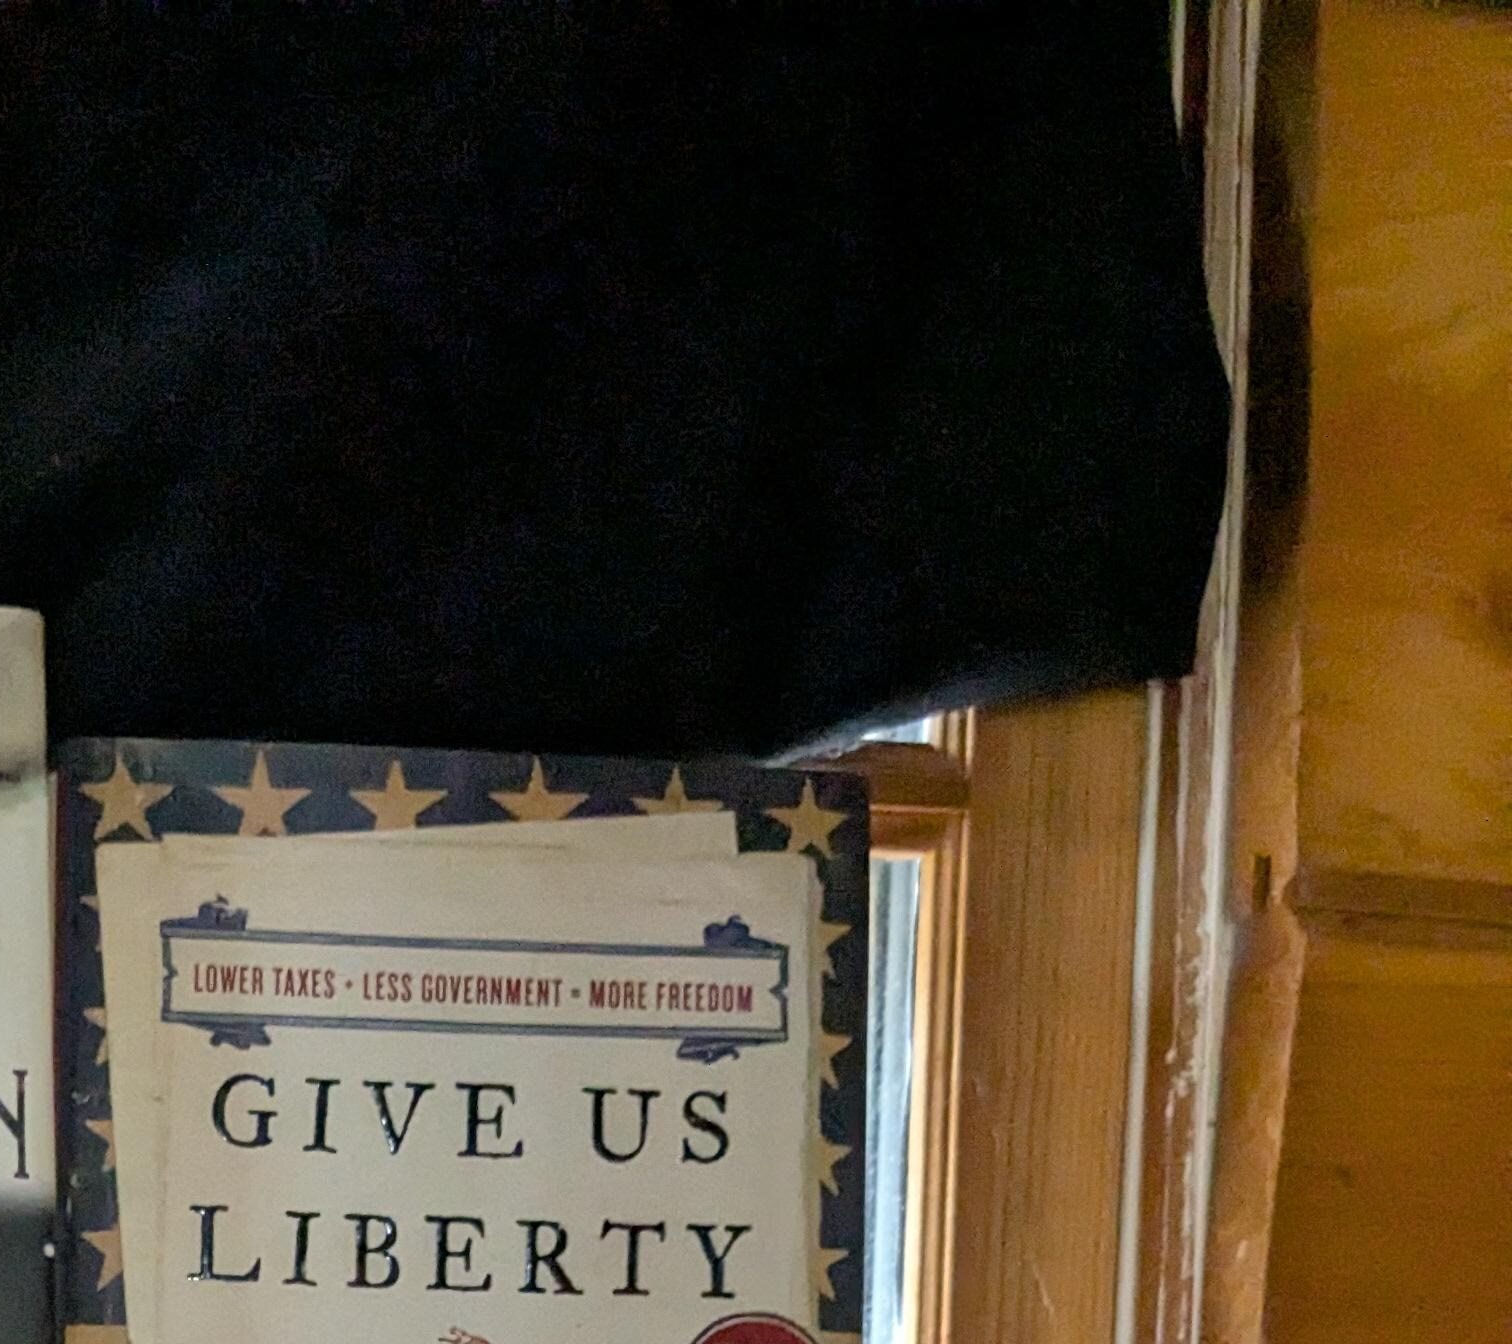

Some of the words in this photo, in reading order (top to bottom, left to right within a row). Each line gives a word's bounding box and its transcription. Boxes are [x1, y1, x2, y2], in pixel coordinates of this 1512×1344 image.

[194, 964, 264, 995] LOWER
[272, 968, 336, 999] TAXES
[362, 972, 412, 1001] LESS
[420, 974, 563, 1007] GOVERNMENT
[589, 980, 647, 1009] MORE
[656, 982, 752, 1013] FREEDOM
[212, 1073, 524, 1159] GIVE
[582, 1087, 731, 1165] US
[187, 1205, 752, 1299] LIBERTY
